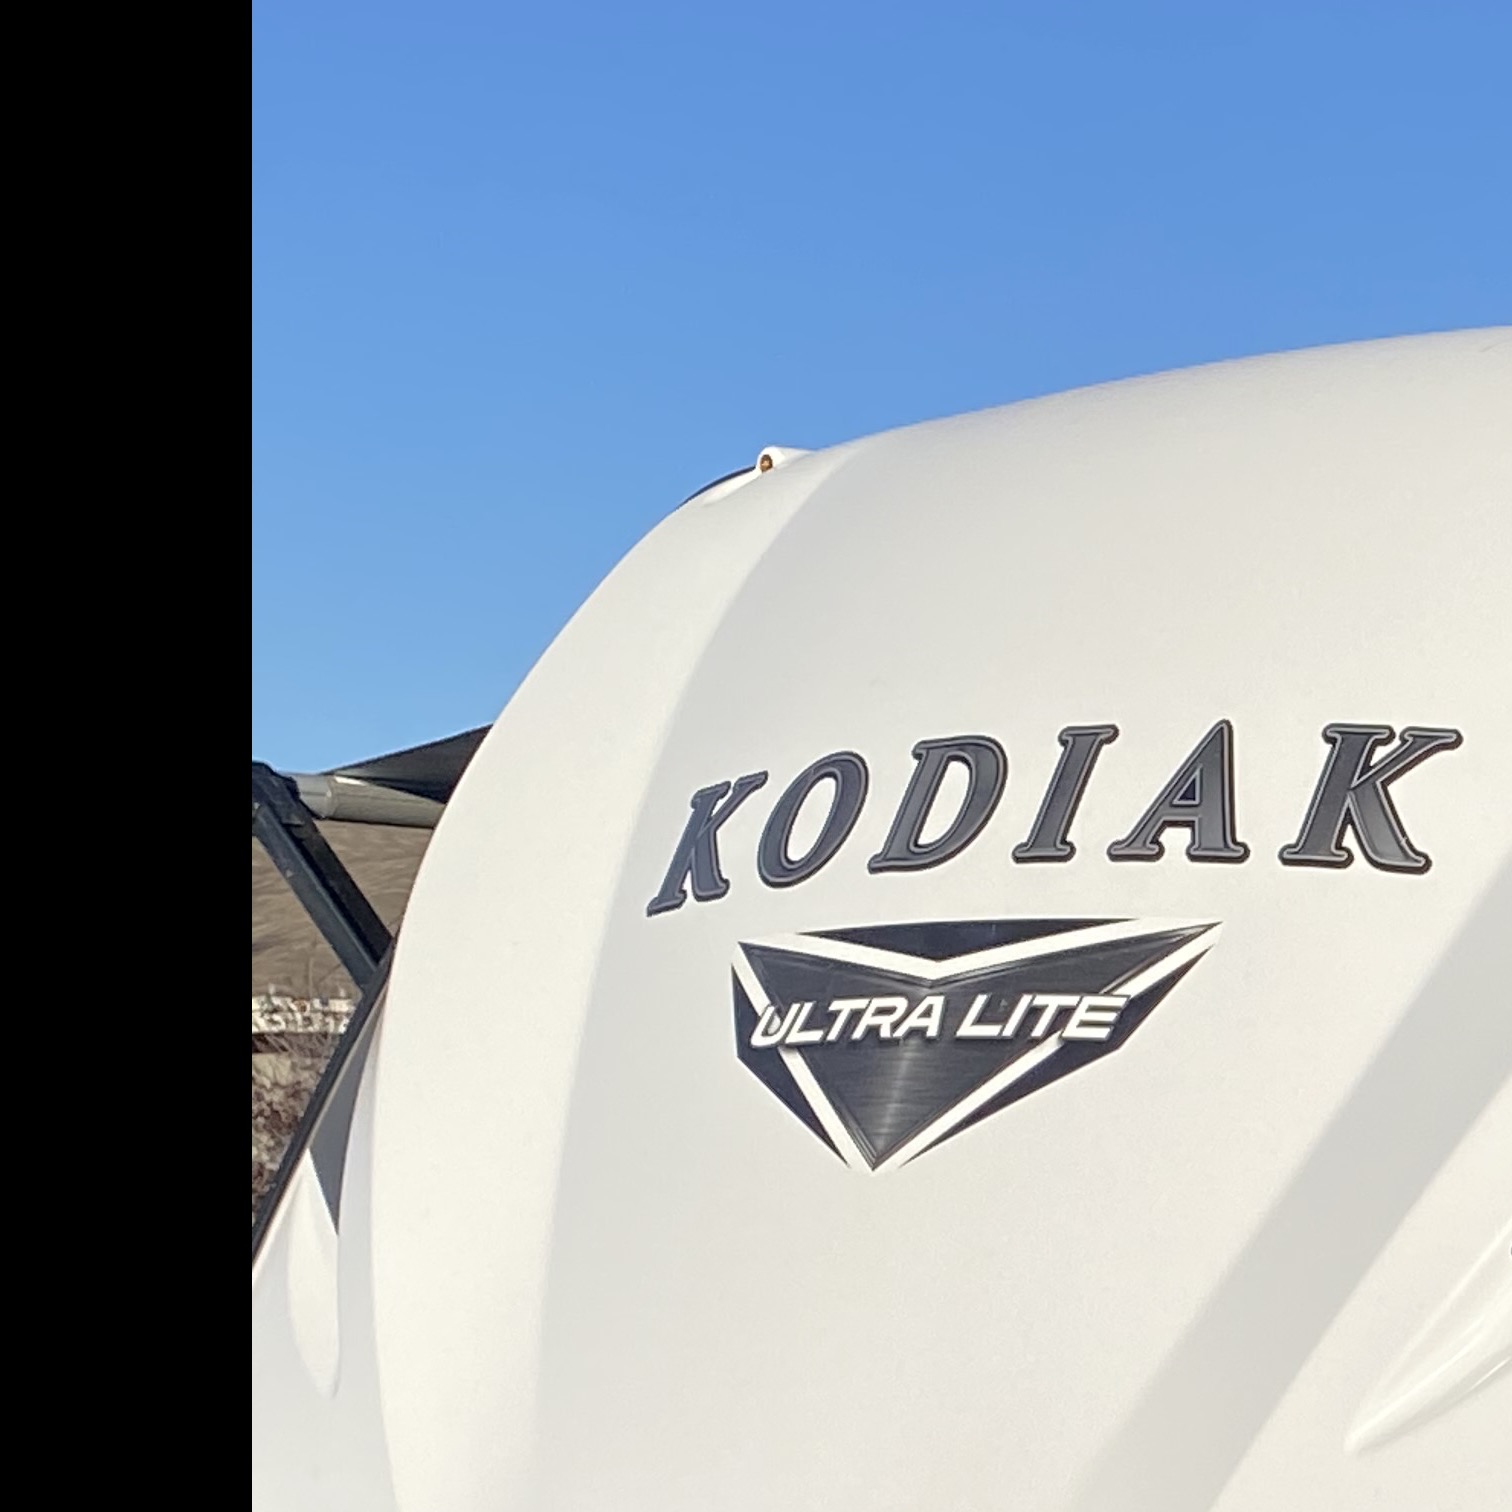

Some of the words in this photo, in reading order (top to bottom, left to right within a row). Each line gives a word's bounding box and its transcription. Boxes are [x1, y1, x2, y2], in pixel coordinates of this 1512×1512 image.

[646, 719, 1463, 916] KODIAK
[750, 994, 946, 1048] ULTRA
[955, 992, 1131, 1041] LITE
